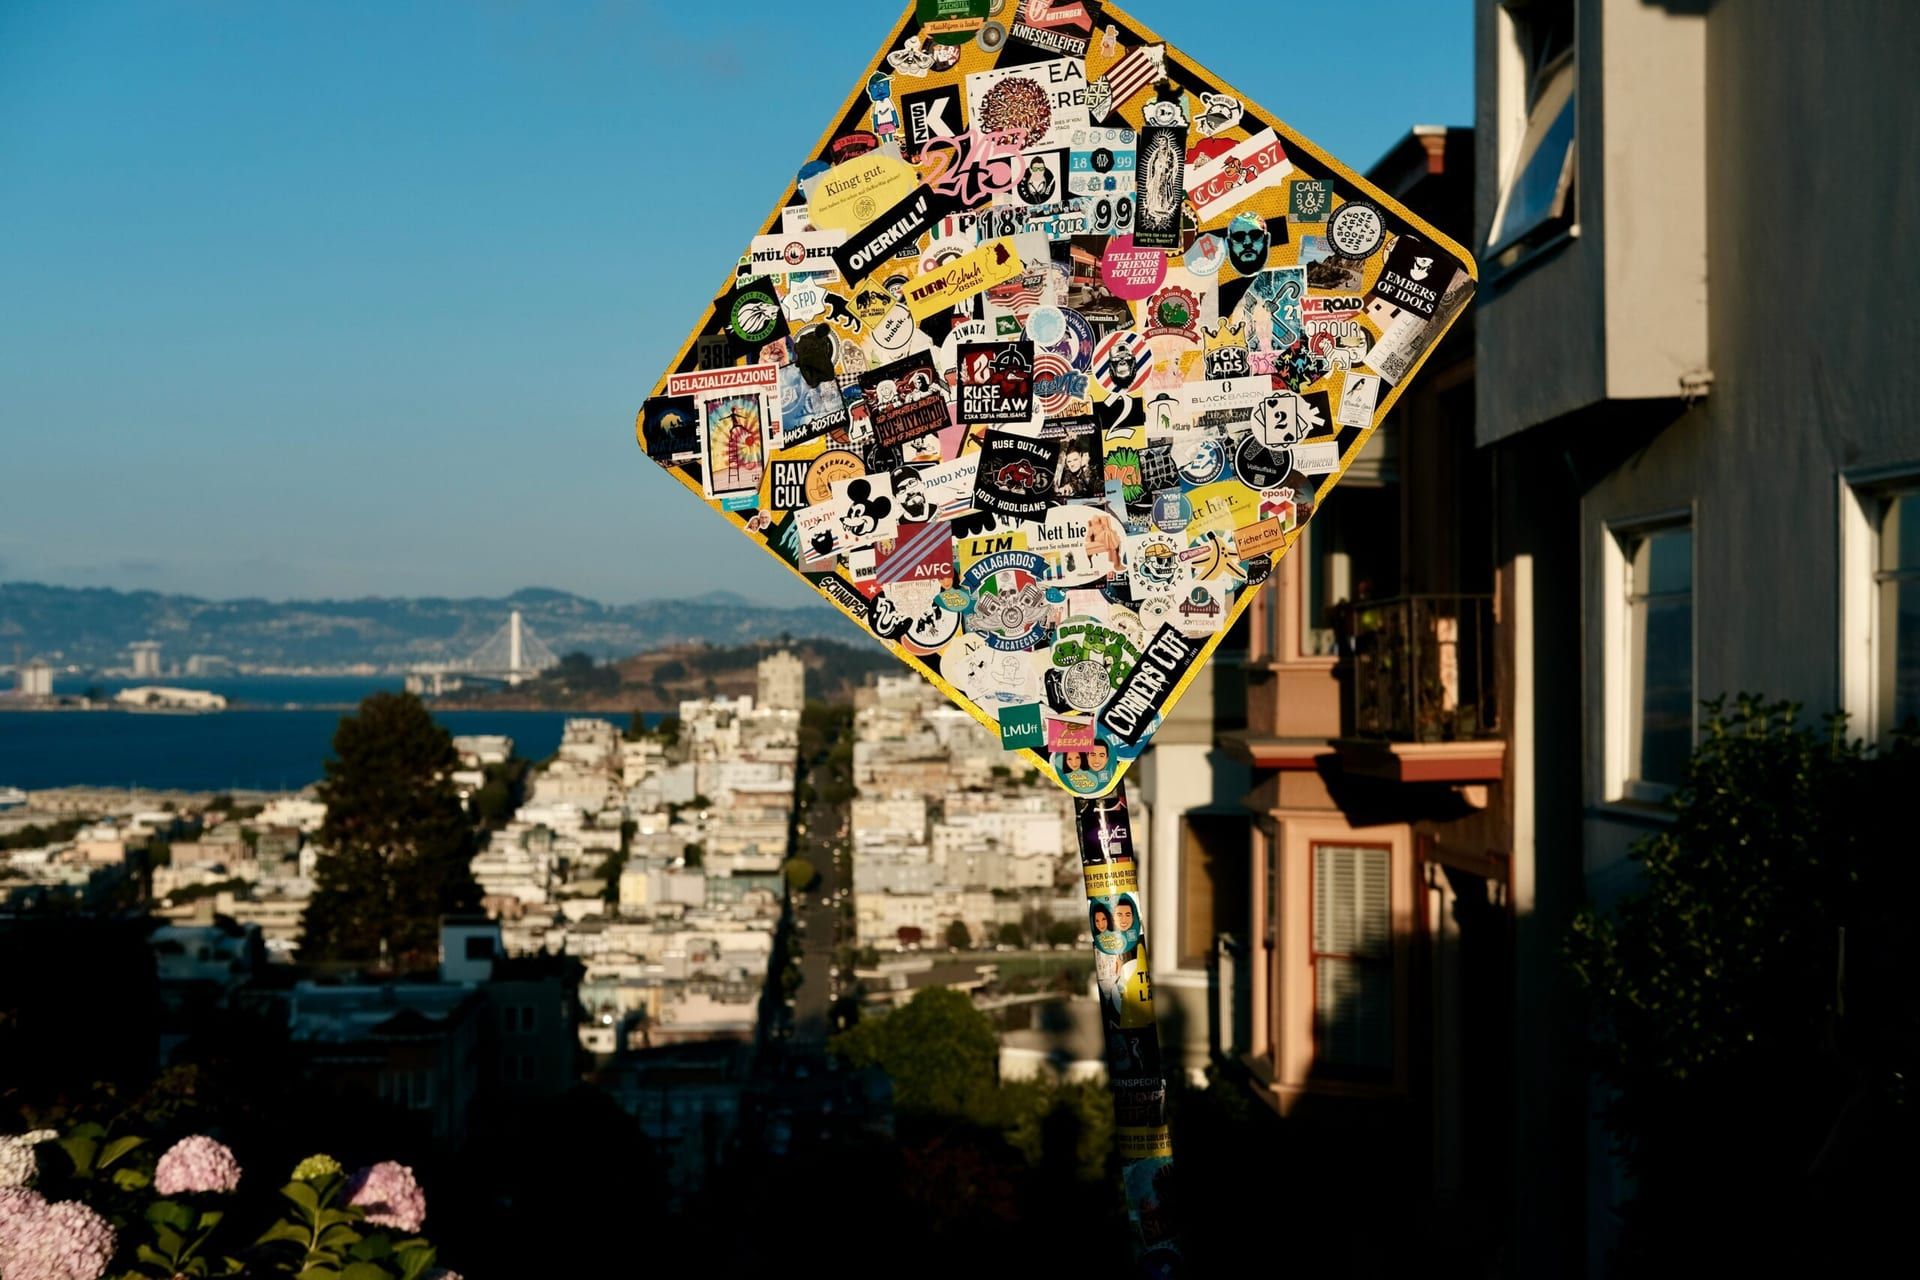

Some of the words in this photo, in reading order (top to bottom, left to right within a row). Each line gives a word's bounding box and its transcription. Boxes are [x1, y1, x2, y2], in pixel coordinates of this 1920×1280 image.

[1012, 23, 1086, 55] KNIESCHLEIFER
[1073, 157, 1087, 169] 18
[1117, 156, 1132, 168] 99
[1258, 145, 1278, 169] 97
[825, 174, 861, 197] Klingt
[863, 164, 886, 183] gut.
[1296, 182, 1326, 192] CARL
[1095, 196, 1133, 231] 99
[1050, 218, 1084, 234] TOUR
[753, 248, 784, 263] MÜL
[1108, 253, 1132, 262] TELL
[1134, 251, 1160, 261] YOUR
[1116, 260, 1159, 270] FRIENDS
[1111, 269, 1131, 278] YOU
[1132, 268, 1158, 277] LOVE
[1023, 277, 1041, 287] 2023
[1127, 277, 1156, 286] THEM
[1385, 271, 1437, 301] EMBERS
[911, 278, 947, 302] TURN
[1377, 281, 1395, 294] OF
[1396, 289, 1434, 314] IDOLS
[792, 290, 817, 310] SFPD
[884, 317, 907, 343] bubek.
[886, 318, 895, 330] ok
[1213, 349, 1241, 362] FCK
[1213, 362, 1243, 374] ADS
[672, 368, 775, 392] DELAZIALIZZAZIONE
[963, 385, 1000, 399] RUSE
[963, 398, 1028, 413] OUTLAW
[811, 410, 846, 432] ROSTOCK
[995, 411, 1027, 419] HOOLIGANS
[1274, 411, 1287, 429] 2
[992, 440, 1014, 450] RUSE
[1017, 441, 1051, 461] OUTLAW
[955, 465, 976, 479] שלא
[775, 486, 809, 508] CUL
[976, 488, 994, 506] 100%
[997, 501, 1047, 513] HOOLIGANS
[1262, 489, 1293, 498] eposly
[1037, 524, 1064, 541] Nett
[1263, 528, 1278, 539] City
[972, 537, 1013, 557] LIM
[914, 562, 952, 577] AVFC
[972, 555, 1036, 580] BALAGARDOS
[994, 632, 1040, 650] ZACATECAS
[1003, 723, 1038, 738] LMUff
[1105, 879, 1125, 888] GULIO
